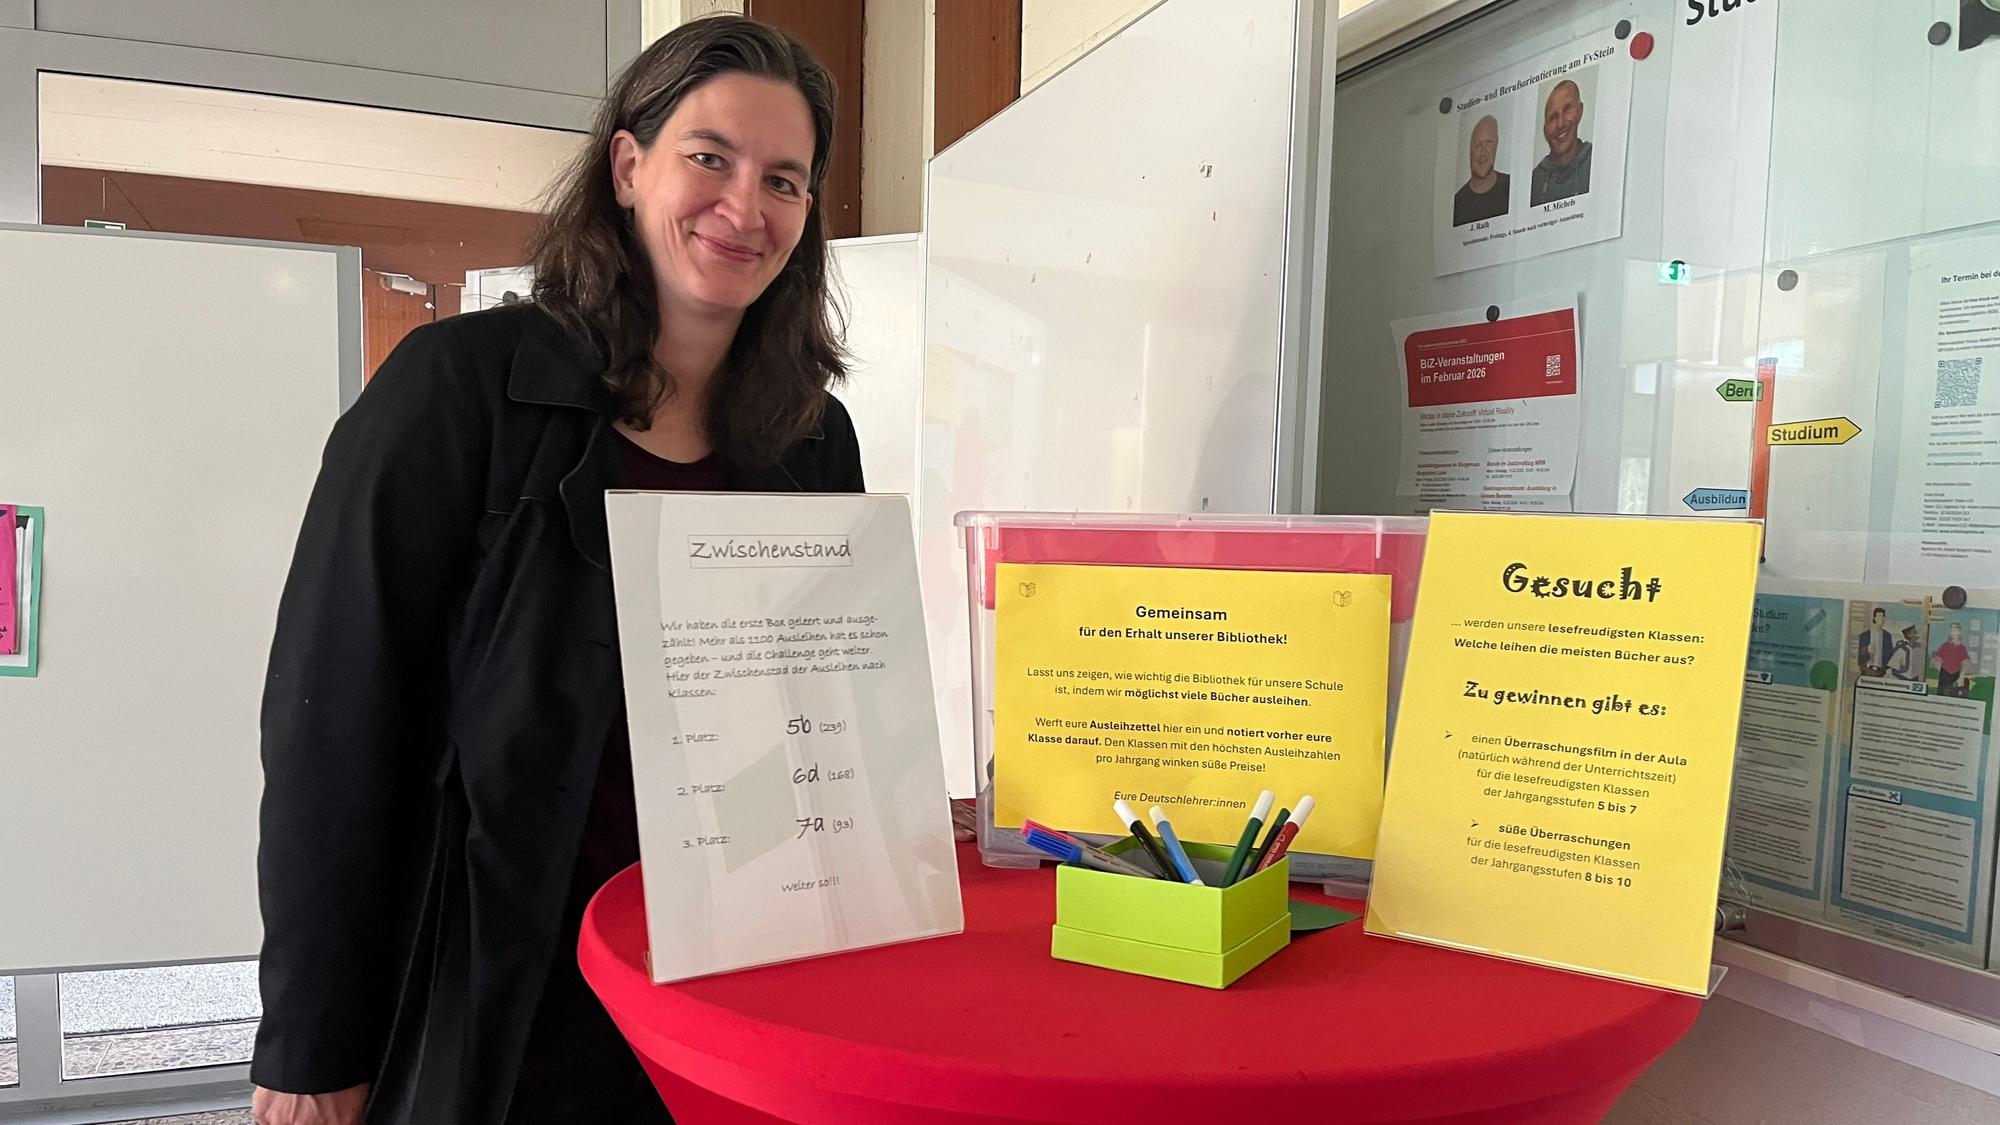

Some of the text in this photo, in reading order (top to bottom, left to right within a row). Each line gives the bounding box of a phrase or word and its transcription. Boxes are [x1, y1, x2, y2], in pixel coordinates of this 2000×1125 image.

[1484, 89, 1498, 102] und
[1499, 63, 1567, 97] Berufsorientierung
[1569, 58, 1581, 70] am
[1583, 45, 1615, 65] FvStein
[1941, 276, 1952, 284] Ihr
[1953, 272, 1979, 282] Termin
[1980, 270, 1992, 279] bei
[1420, 352, 1504, 369] BiZ-Veranstaltungen
[1421, 367, 1486, 384] im Februar 2026
[1771, 425, 1839, 442] Studium
[1690, 494, 1747, 505] Ausbildun
[690, 539, 852, 559] Zwischenstand
[1502, 562, 1662, 602] Gesucht
[660, 615, 878, 631] Wir haben die erste Box geleert und ausge-
[1135, 606, 1227, 621] Gemeinsam
[700, 636, 727, 646] Mehr
[729, 635, 745, 645] als
[748, 635, 773, 644] 1100
[776, 631, 827, 643] Ausleihen
[829, 630, 847, 640] hat
[848, 632, 858, 640] es
[860, 630, 888, 639] schon
[1079, 627, 1288, 645] für den Erhalt unserer Bibliothek!
[1464, 619, 1705, 643] werden unsere lesefreudigsten Klassen:
[664, 653, 710, 668] gegeben
[721, 651, 743, 662] und
[746, 650, 762, 660] die
[765, 648, 815, 661] Challenge
[818, 647, 840, 660] geht
[1454, 638, 1695, 665] Welche leihen die meisten Bücher aus?
[666, 670, 690, 681] Hier
[693, 670, 710, 680] der
[792, 665, 808, 675] der
[810, 661, 860, 673] Ausleihen
[862, 660, 886, 670] nach
[1027, 667, 1344, 691] Lasst uns zeigen, wie wichtig die Bibliothek für unsere Schule
[1055, 684, 1312, 707] ist, indem wir möglichst viele Bücher ausleihen.
[1463, 680, 1667, 716] Zu gewinnen gibt es:
[786, 714, 812, 735] 5b
[819, 720, 847, 735] (239)
[1035, 717, 1332, 743] Werft eure Ausleihzettel hier ein und notiert vorher eure
[1028, 733, 1341, 761] Klasse darauf. Den Klassen mit den höchsten Ausleihzahlen
[1472, 734, 1688, 766] einen Überraschungsfilm in der Aula
[792, 762, 820, 784] 6d
[828, 768, 855, 782] (168)
[1096, 754, 1266, 773] pro Jahrgang winken süße Preise!
[1458, 749, 1677, 785] (natürlich während der Unterrichtszeit)
[1477, 768, 1650, 798] für die lesefreudigsten Klassen
[1113, 791, 1247, 809] Eure Deutschlehrer:innen
[1484, 786, 1637, 814] der Jahrgangsstufen 5 bis 7
[795, 816, 825, 840] 7a
[832, 818, 854, 834] (93)
[1499, 824, 1631, 851] süße Überraschungen
[1467, 836, 1641, 870] für die lesefreudigsten Klassen
[1471, 855, 1632, 888] der Jahrgangsstufen 8 bis 10
[781, 876, 840, 892] Weiter so!!!
